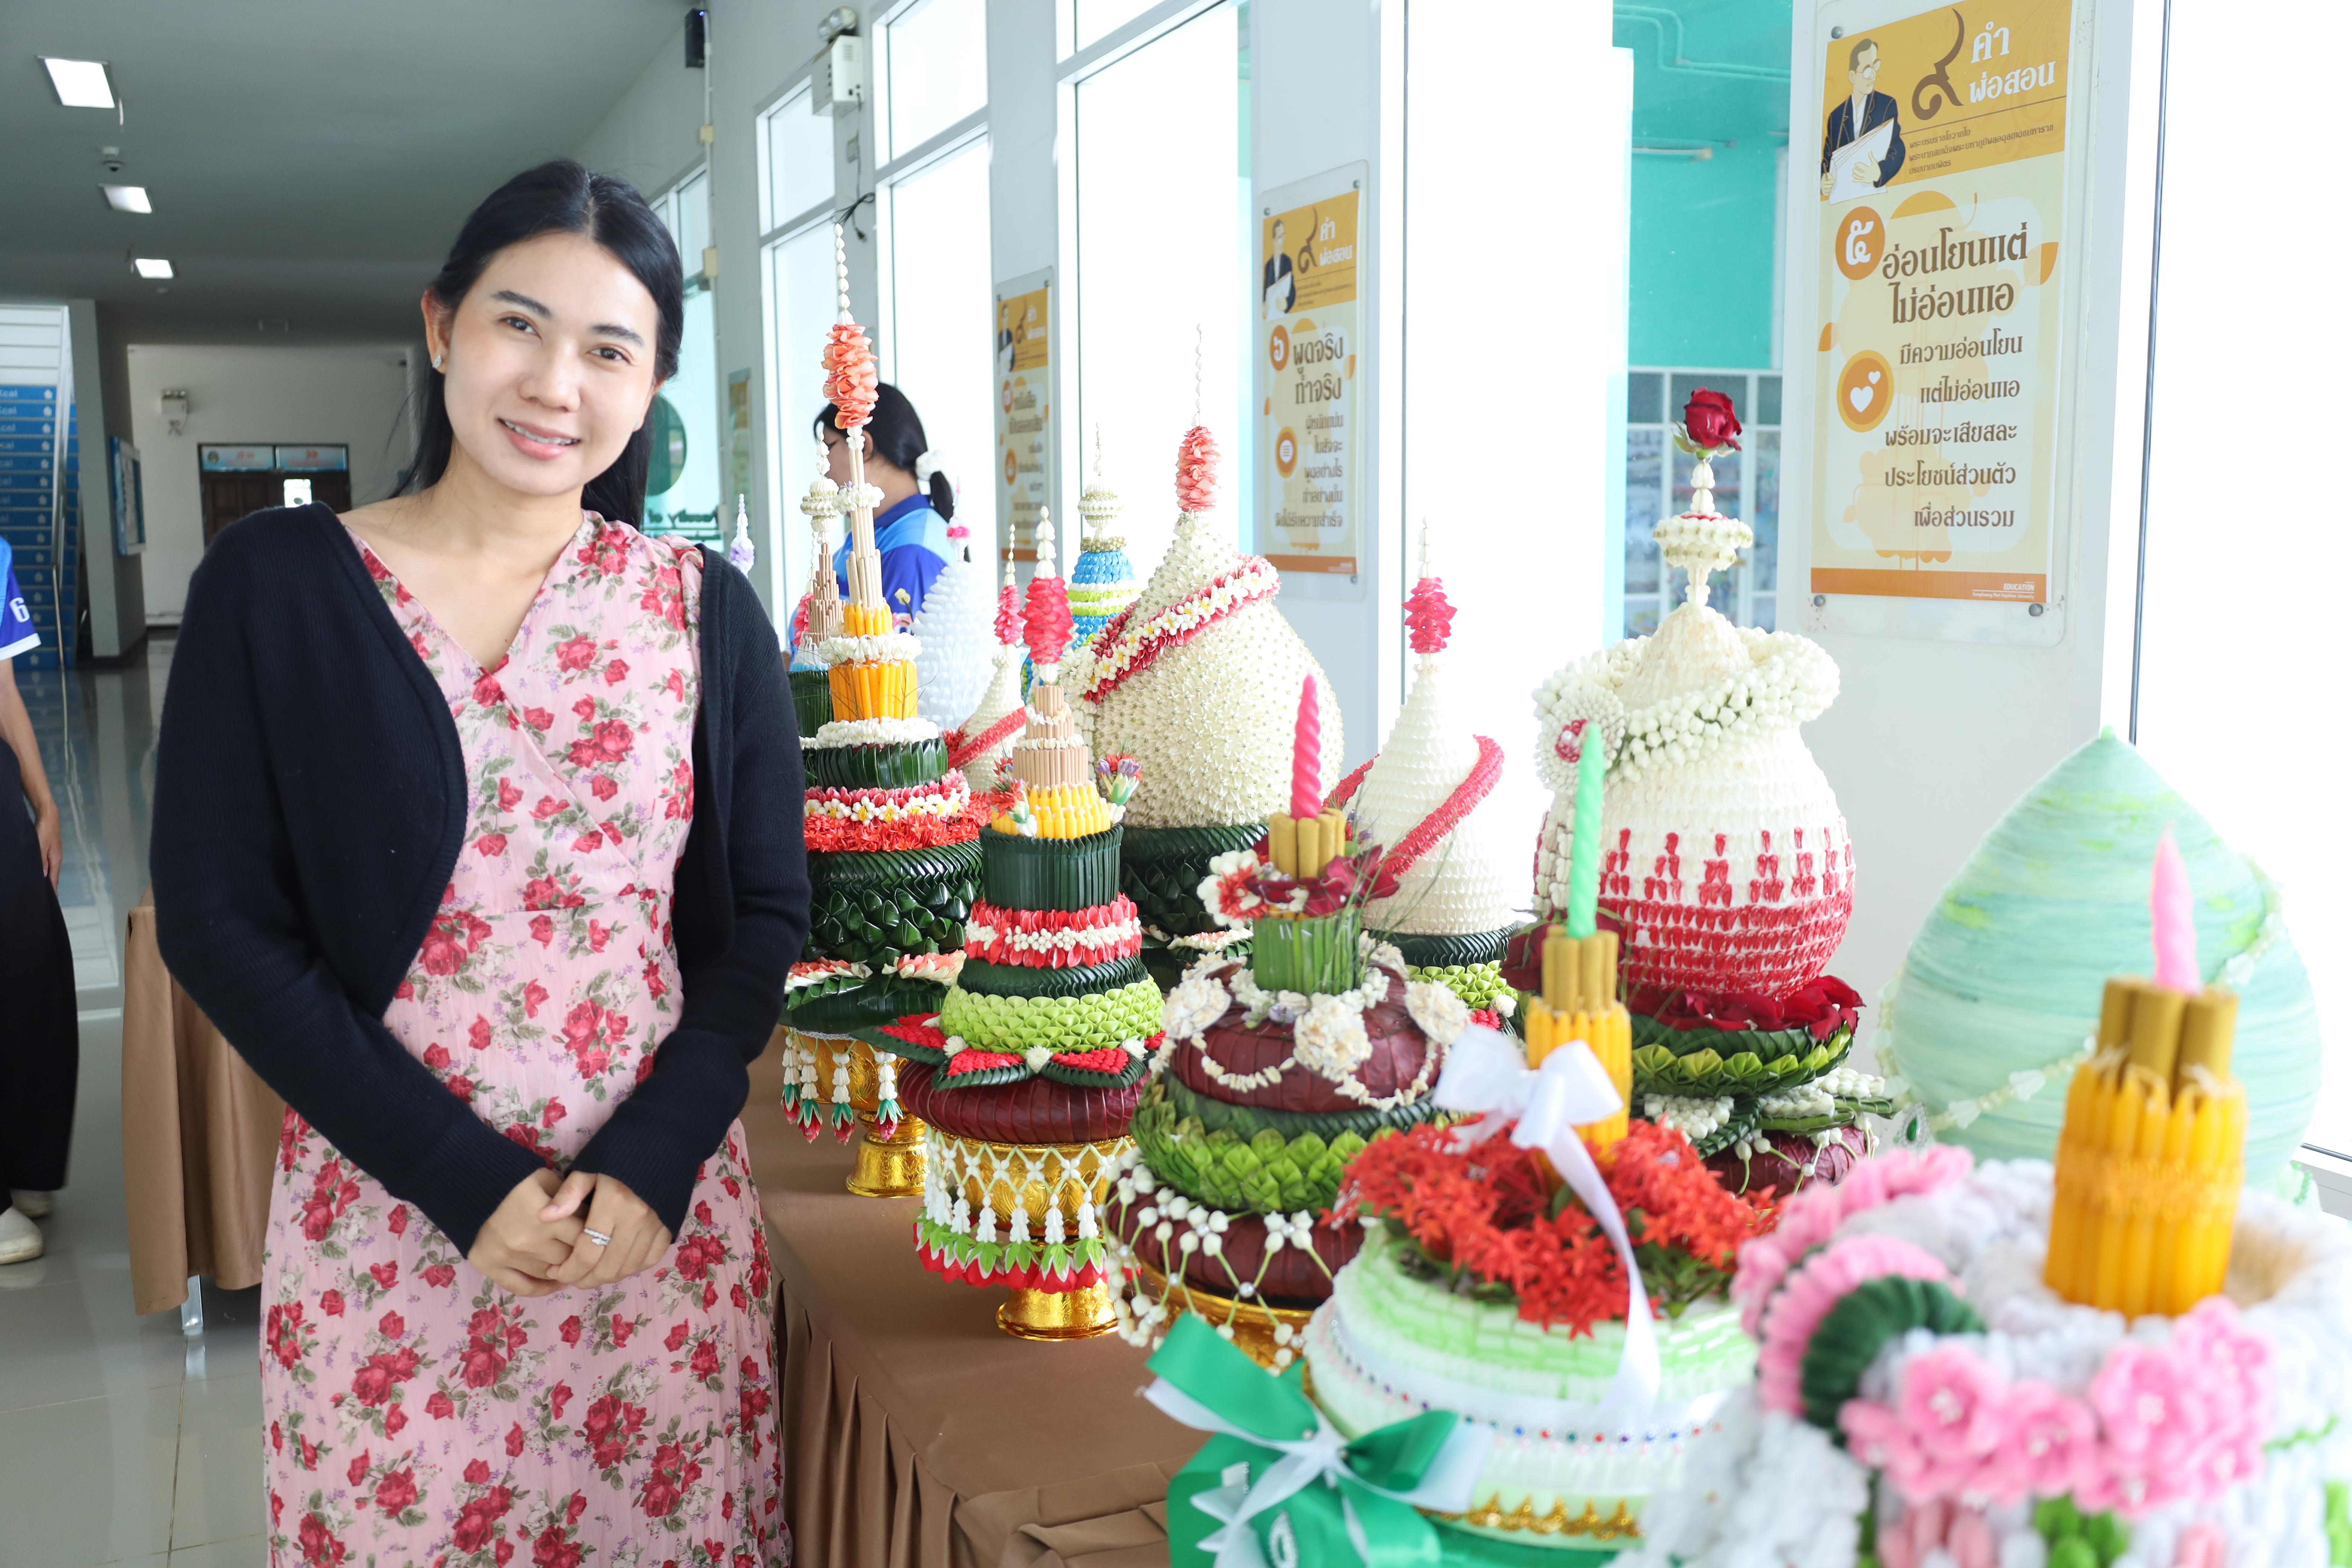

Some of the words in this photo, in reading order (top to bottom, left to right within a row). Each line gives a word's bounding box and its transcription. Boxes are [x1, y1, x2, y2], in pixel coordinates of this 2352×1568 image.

[1971, 21, 2010, 64] คำ
[1912, 8, 1965, 121] ๙
[1969, 60, 2055, 104] พ่อสอน
[1845, 219, 1874, 265] ๕
[1882, 222, 2028, 280] อ่อนโยนแต่
[1888, 282, 2015, 325] ไม่อ่อนแอ
[1293, 332, 1344, 374] พูดจริง
[1899, 328, 2023, 365] มีความอ่อนโยน
[1295, 373, 1342, 404] ทำจริง
[1920, 375, 2020, 404] แต่ไม่อ่อนแอ
[1885, 421, 2018, 447] พร้อมจะเสียสละ
[1885, 460, 2017, 487] ประโยชน์ส่วนตัว
[1914, 501, 2015, 527] เพื่อส่วนรวม
[9, 597, 30, 622] 6
